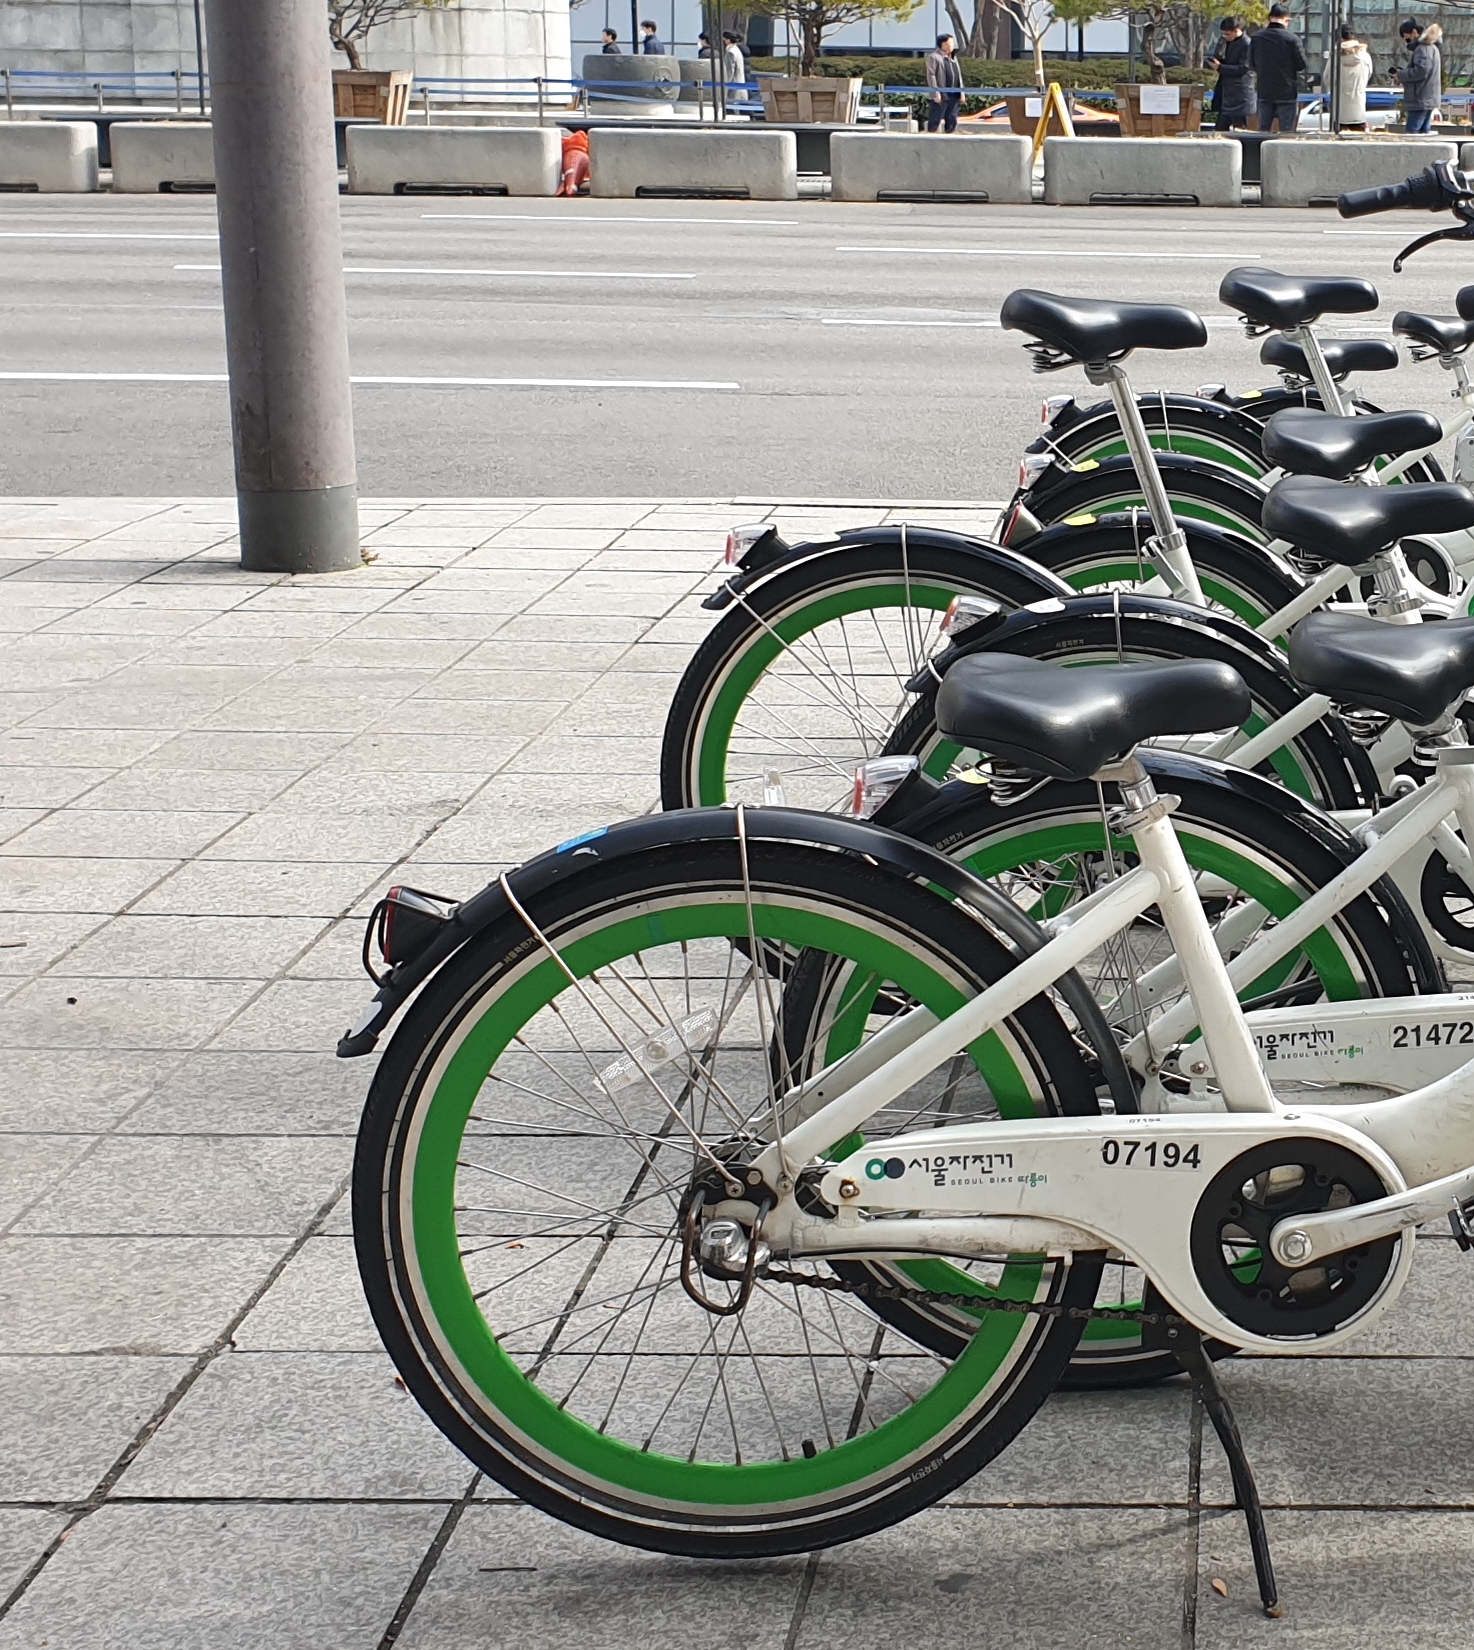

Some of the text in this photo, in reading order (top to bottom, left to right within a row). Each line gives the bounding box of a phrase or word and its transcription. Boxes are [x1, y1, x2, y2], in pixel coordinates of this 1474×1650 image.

[1393, 1021, 1474, 1048] 21472
[1281, 1051, 1310, 1060] SEOUL
[1102, 1139, 1201, 1169] 07194
[908, 1153, 1014, 1187] 서울자전거
[950, 1172, 1048, 1188] SEOUL BIKE 따릉이
